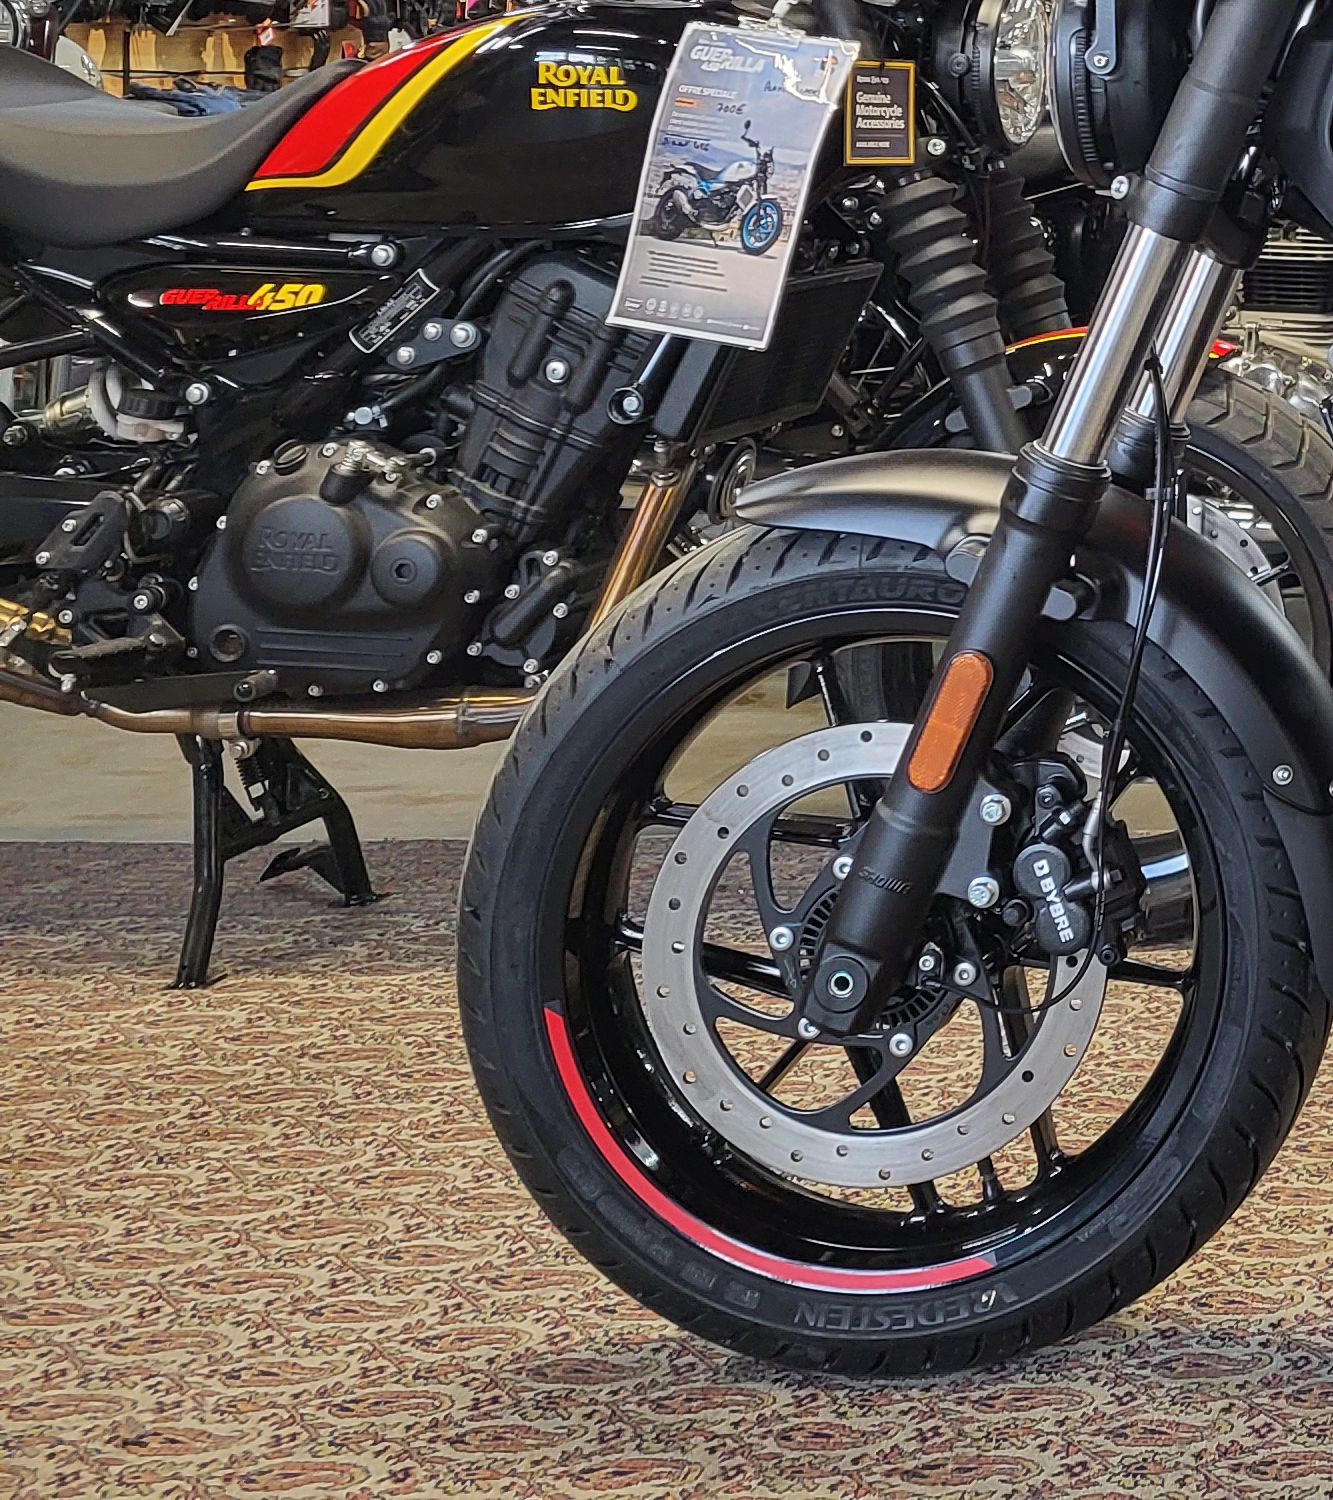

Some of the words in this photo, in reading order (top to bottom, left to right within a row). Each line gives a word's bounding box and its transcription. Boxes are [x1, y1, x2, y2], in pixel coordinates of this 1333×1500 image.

[537, 61, 626, 88] ROYAL
[530, 84, 639, 113] ENFIELD
[856, 91, 891, 104] Genuine
[856, 104, 903, 118] Motorcycle
[856, 117, 905, 129] Accessories
[247, 283, 326, 311] 450
[261, 524, 333, 552] ROYAL
